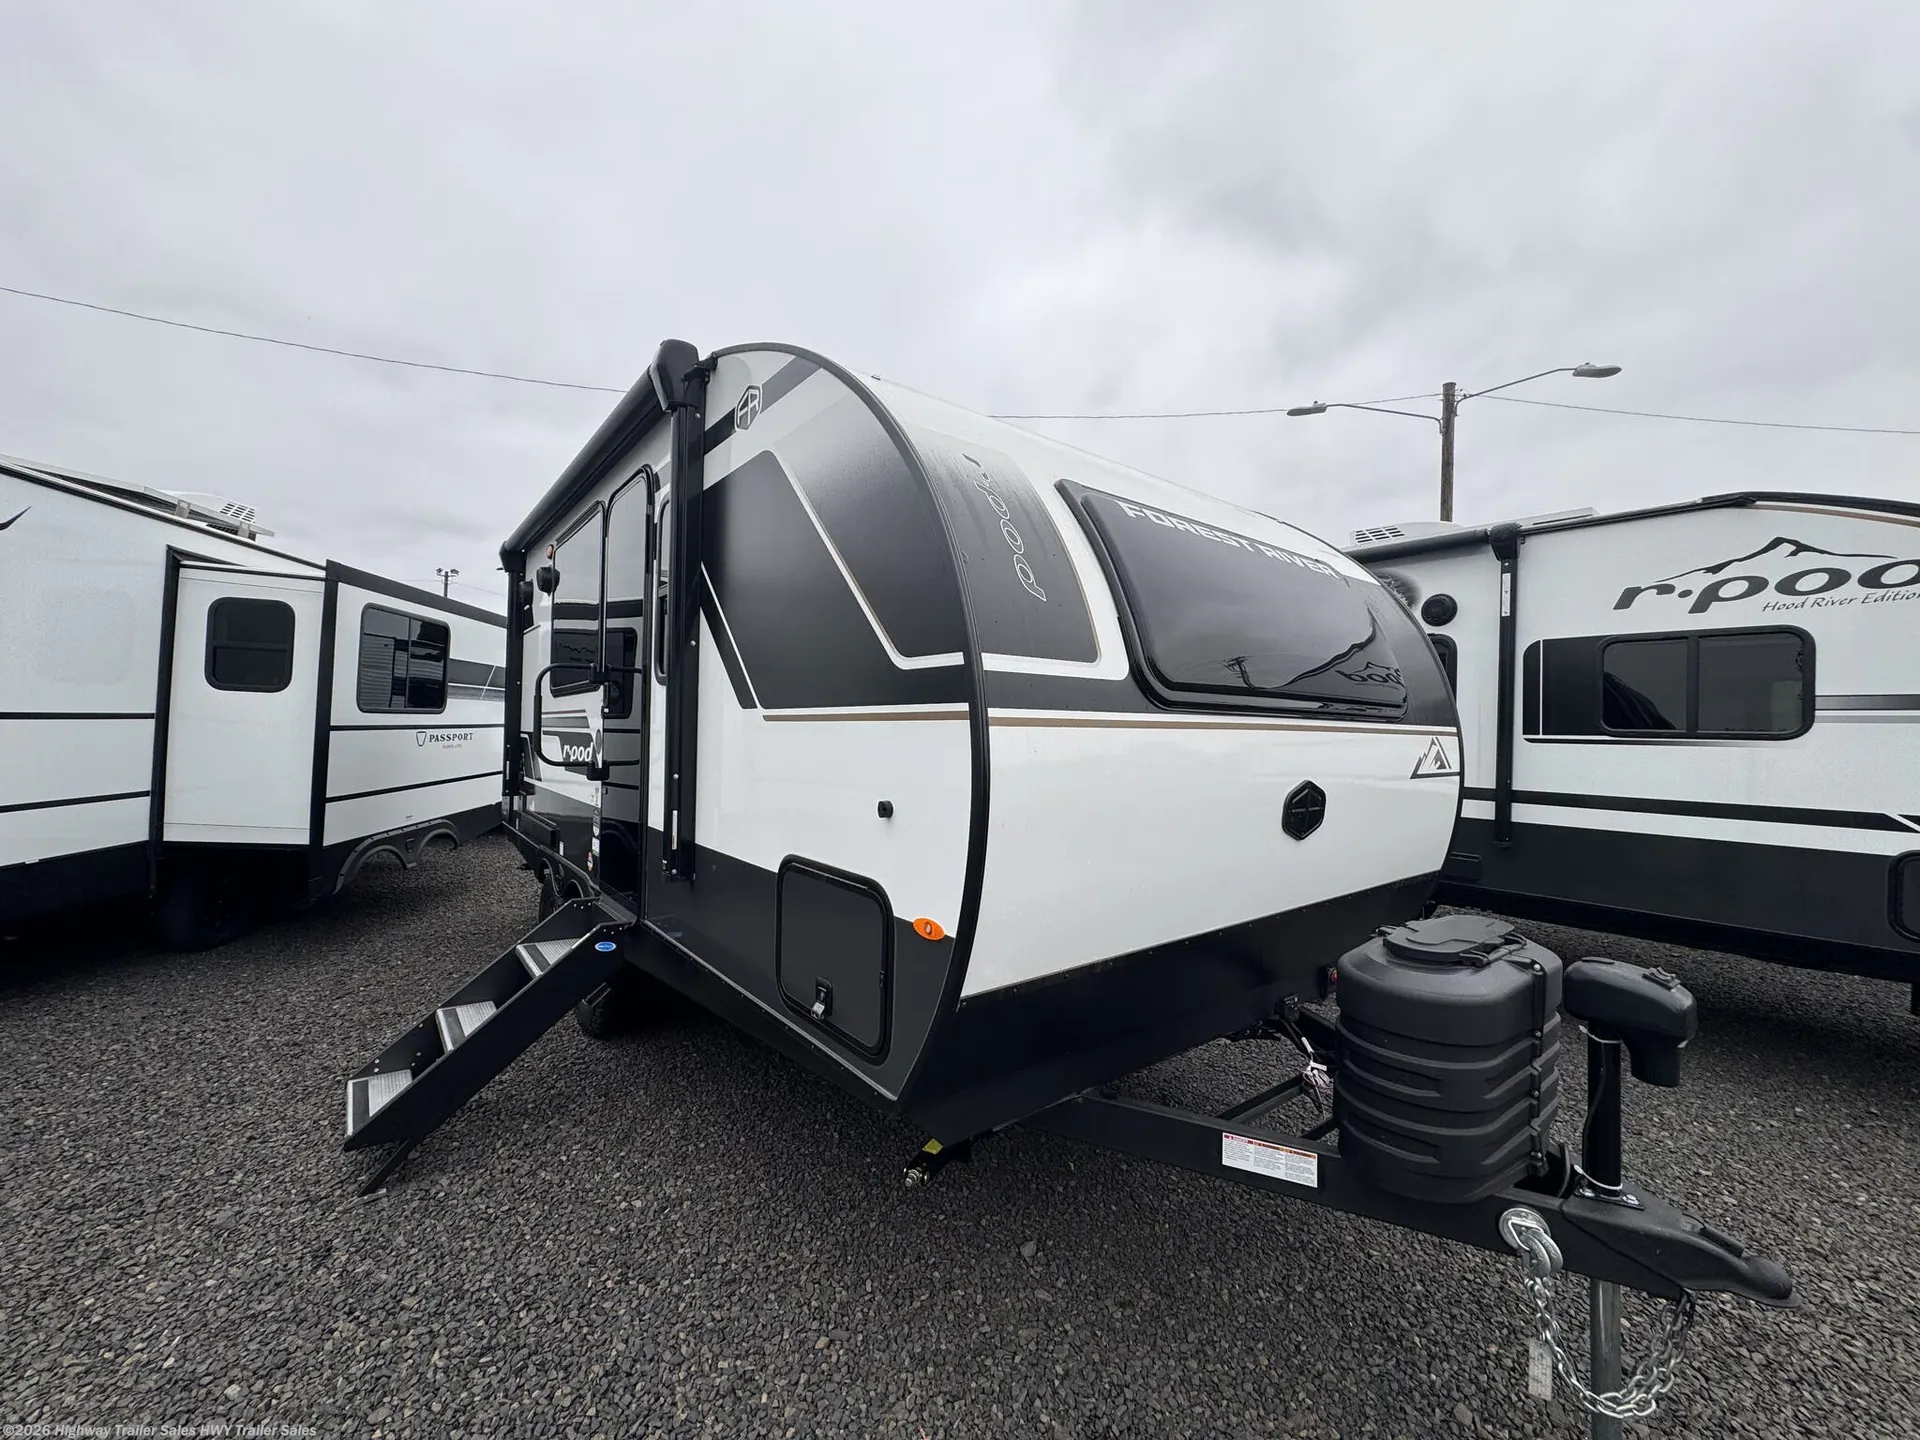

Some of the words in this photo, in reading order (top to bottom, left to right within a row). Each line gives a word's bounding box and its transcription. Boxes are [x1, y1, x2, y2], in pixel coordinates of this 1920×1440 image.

[1117, 500, 1256, 553] FOREST
[1250, 543, 1341, 580] RIVER
[1762, 597, 1809, 612] Hood
[1810, 597, 1858, 609] River
[429, 732, 474, 743] PASSPORT
